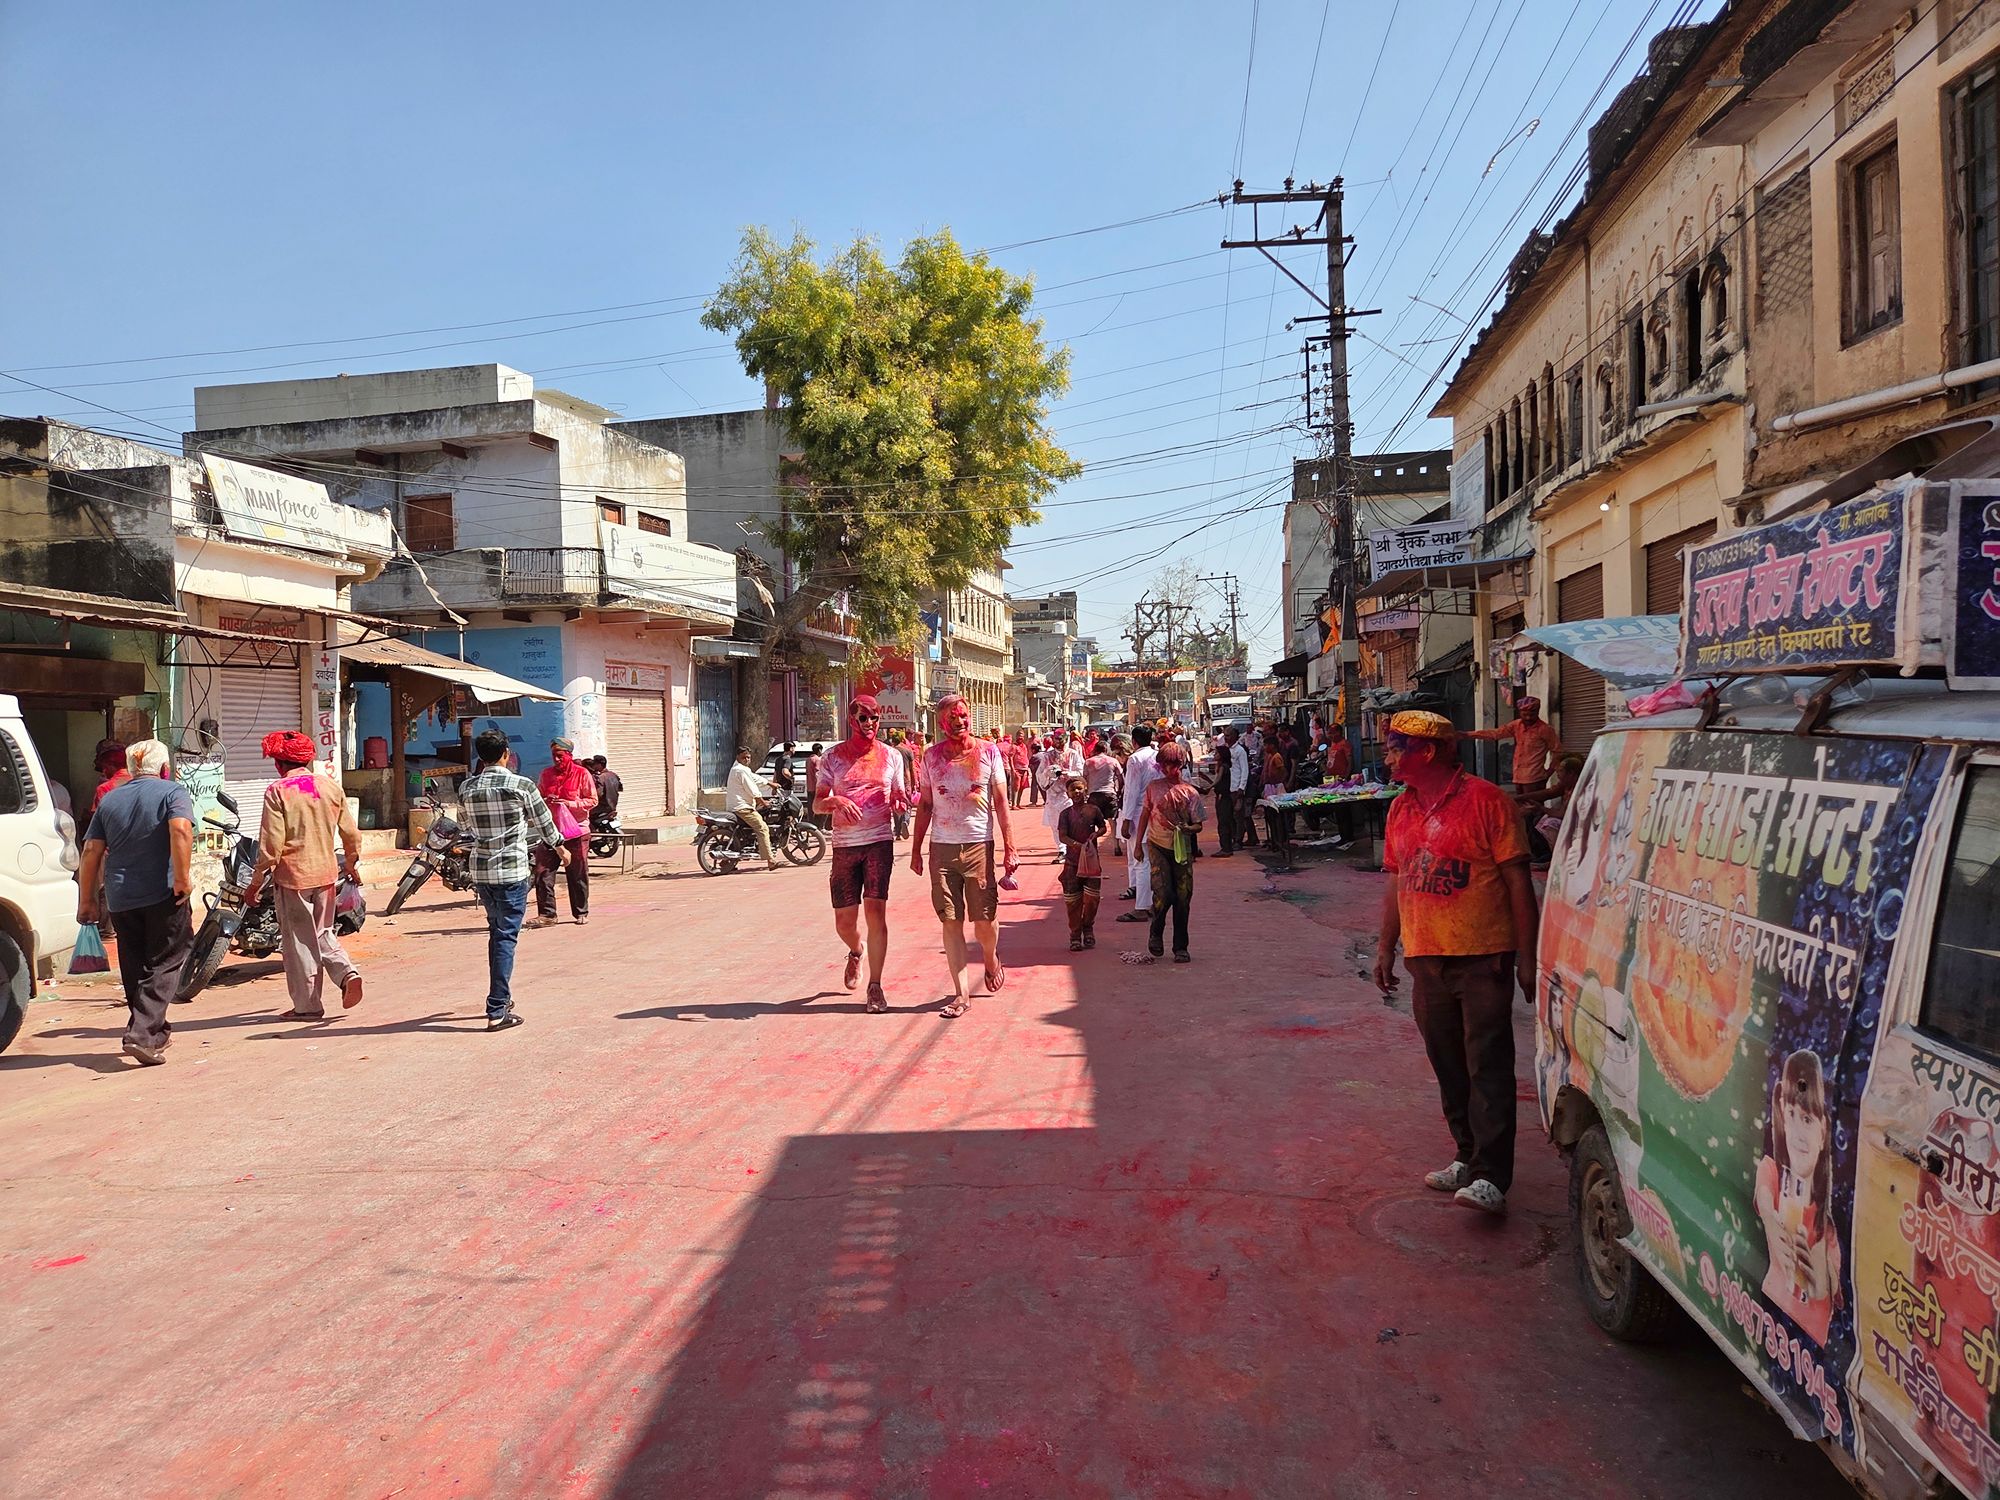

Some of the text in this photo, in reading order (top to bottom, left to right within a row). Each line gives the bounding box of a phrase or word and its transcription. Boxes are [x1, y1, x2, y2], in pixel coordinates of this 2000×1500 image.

[245, 486, 320, 524] MANforce
[1376, 535, 1391, 552] श्री
[1432, 531, 1462, 546] सभा
[1376, 549, 1465, 572] आदर्श विद्या मन्दिर
[1693, 568, 1749, 637] उत्सव
[1747, 543, 1804, 630] सोडा
[1802, 528, 1895, 621] सेन्टर
[1757, 628, 1777, 665] हेतु
[1778, 616, 1845, 655] किफायती
[1847, 614, 1872, 648] रेट
[880, 705, 901, 714] MAL
[1775, 745, 1901, 895] सेन्टर
[1726, 893, 1823, 996] किफायती
[1824, 915, 1856, 1001] रेट
[1719, 1270, 1843, 1436] 9887331945
